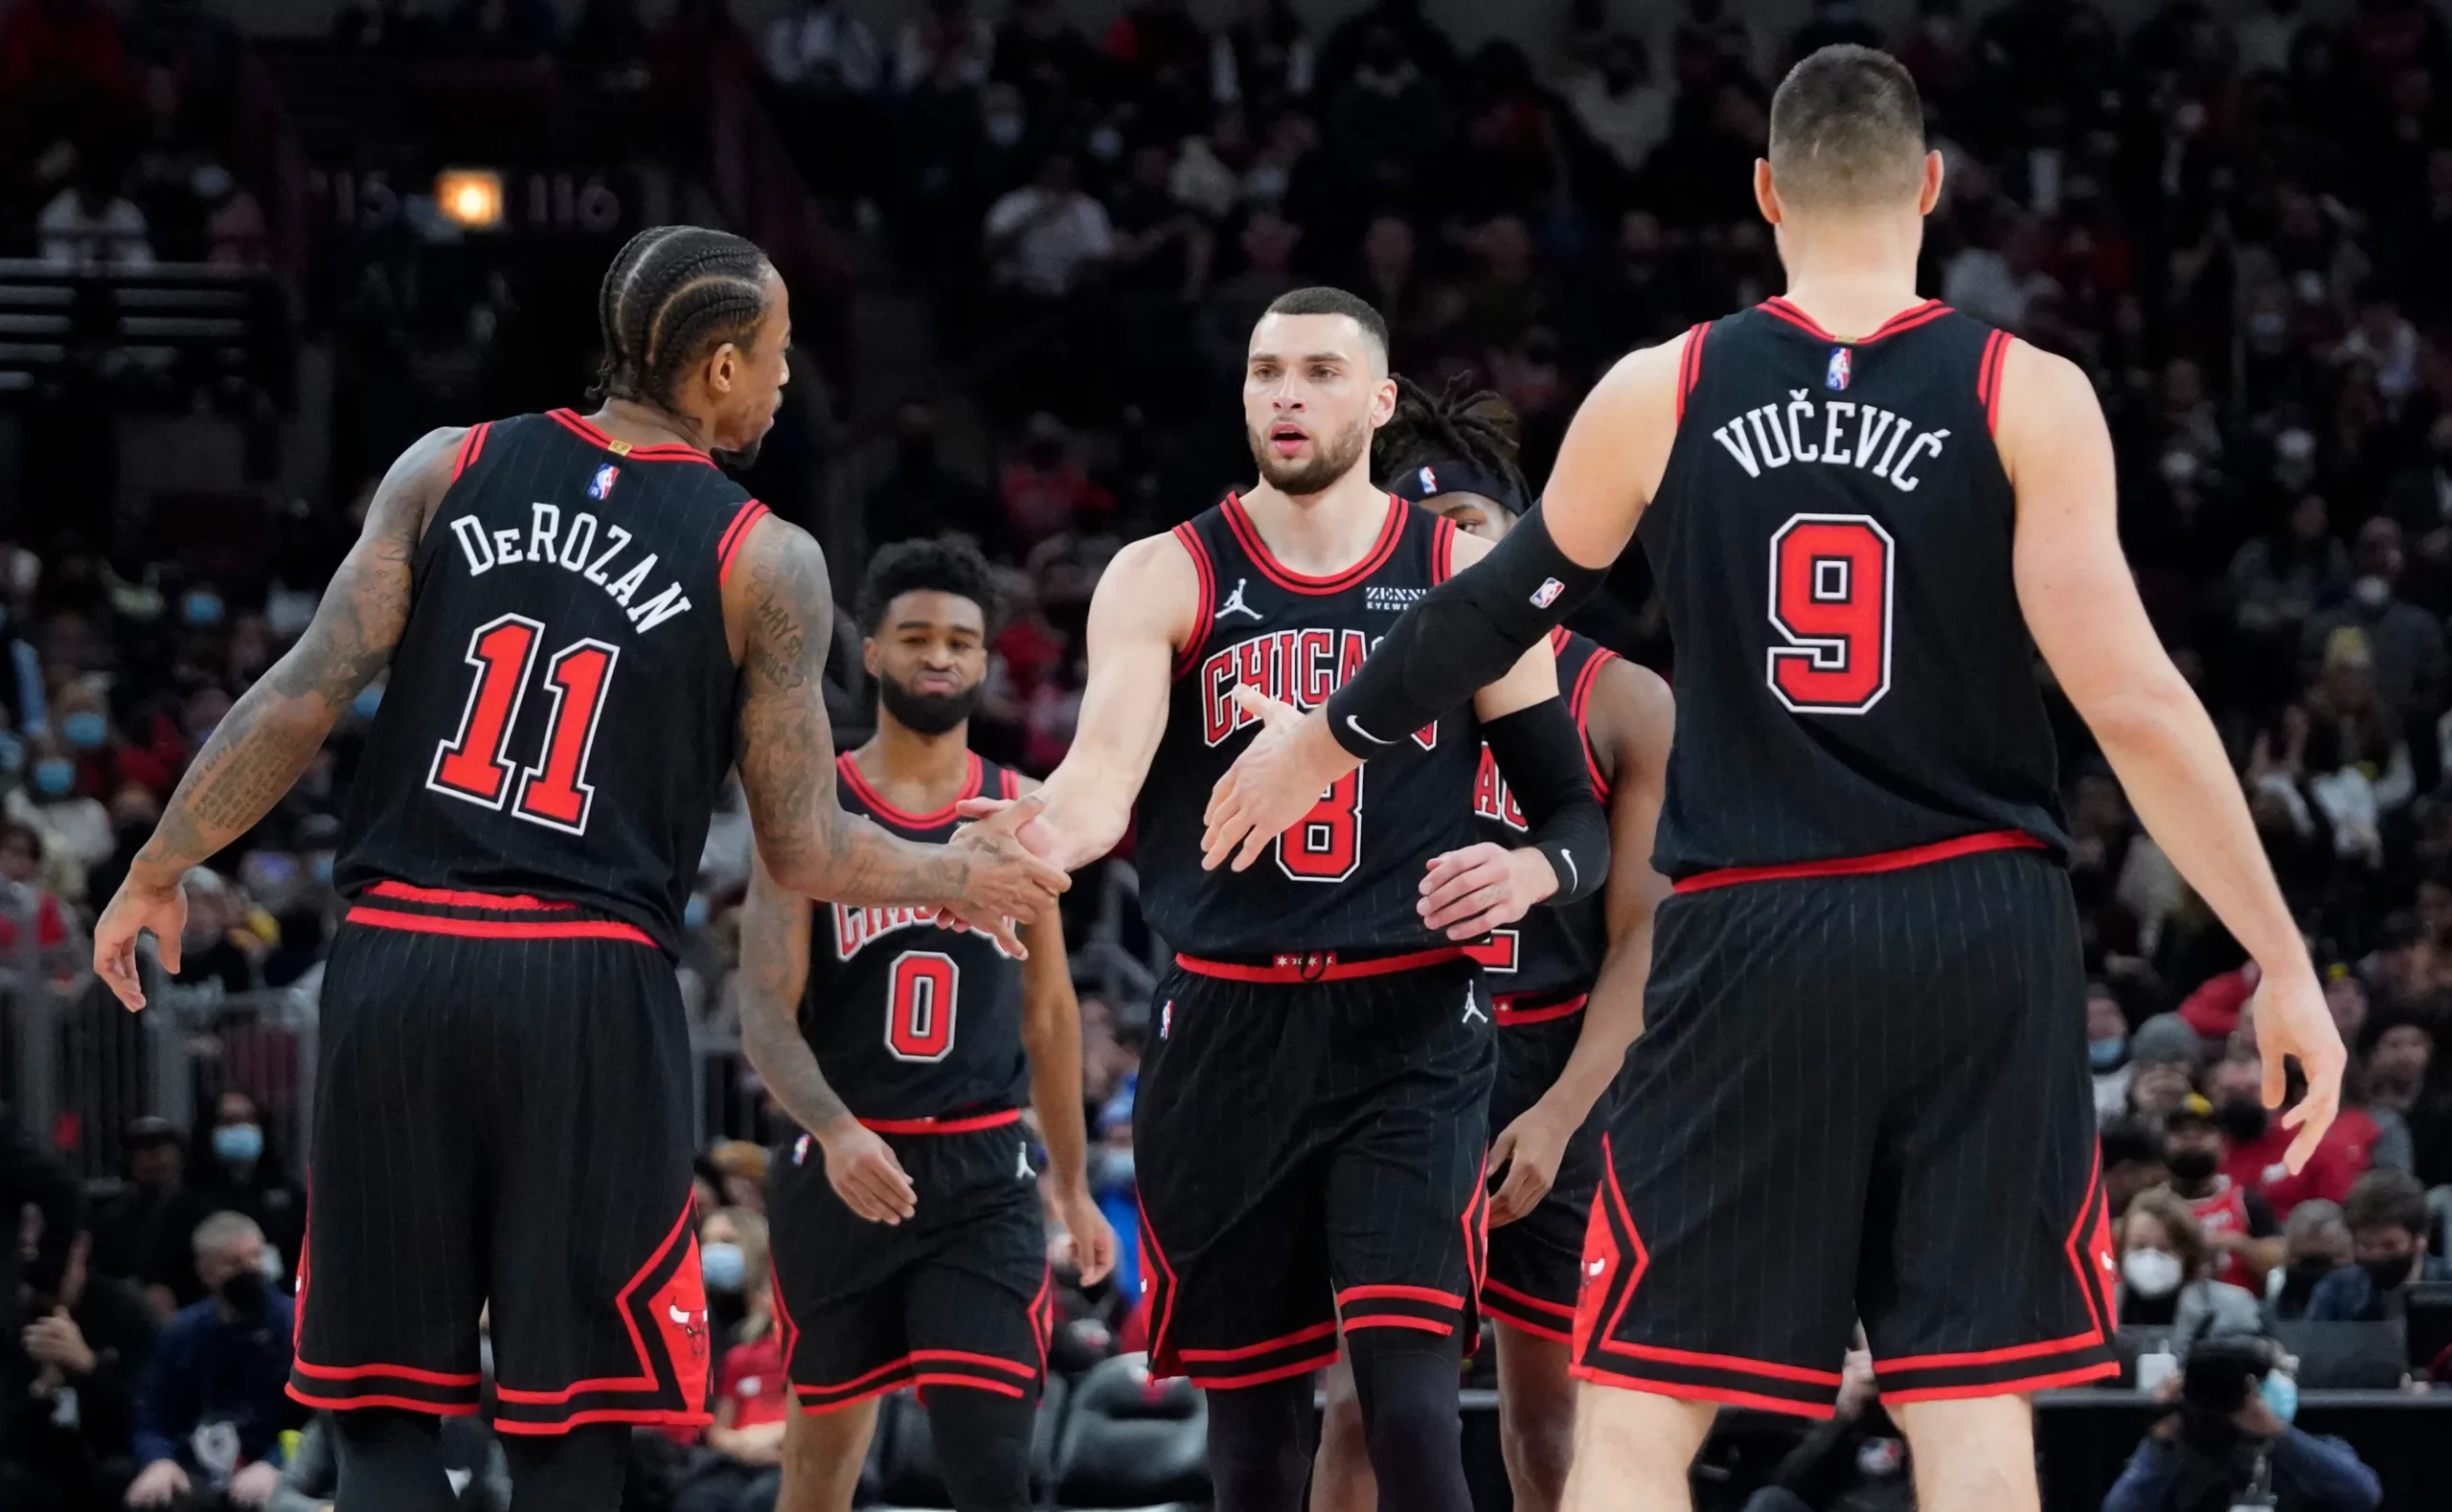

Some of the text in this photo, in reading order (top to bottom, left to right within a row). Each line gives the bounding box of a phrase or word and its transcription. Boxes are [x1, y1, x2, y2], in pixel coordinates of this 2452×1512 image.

[1713, 388, 1951, 491] VUČEVIĆ
[1766, 513, 1895, 715] 9
[425, 613, 621, 836] 11
[1201, 628, 1437, 751] CHICA
[1276, 763, 1364, 883] 8
[884, 950, 959, 1062] 0
